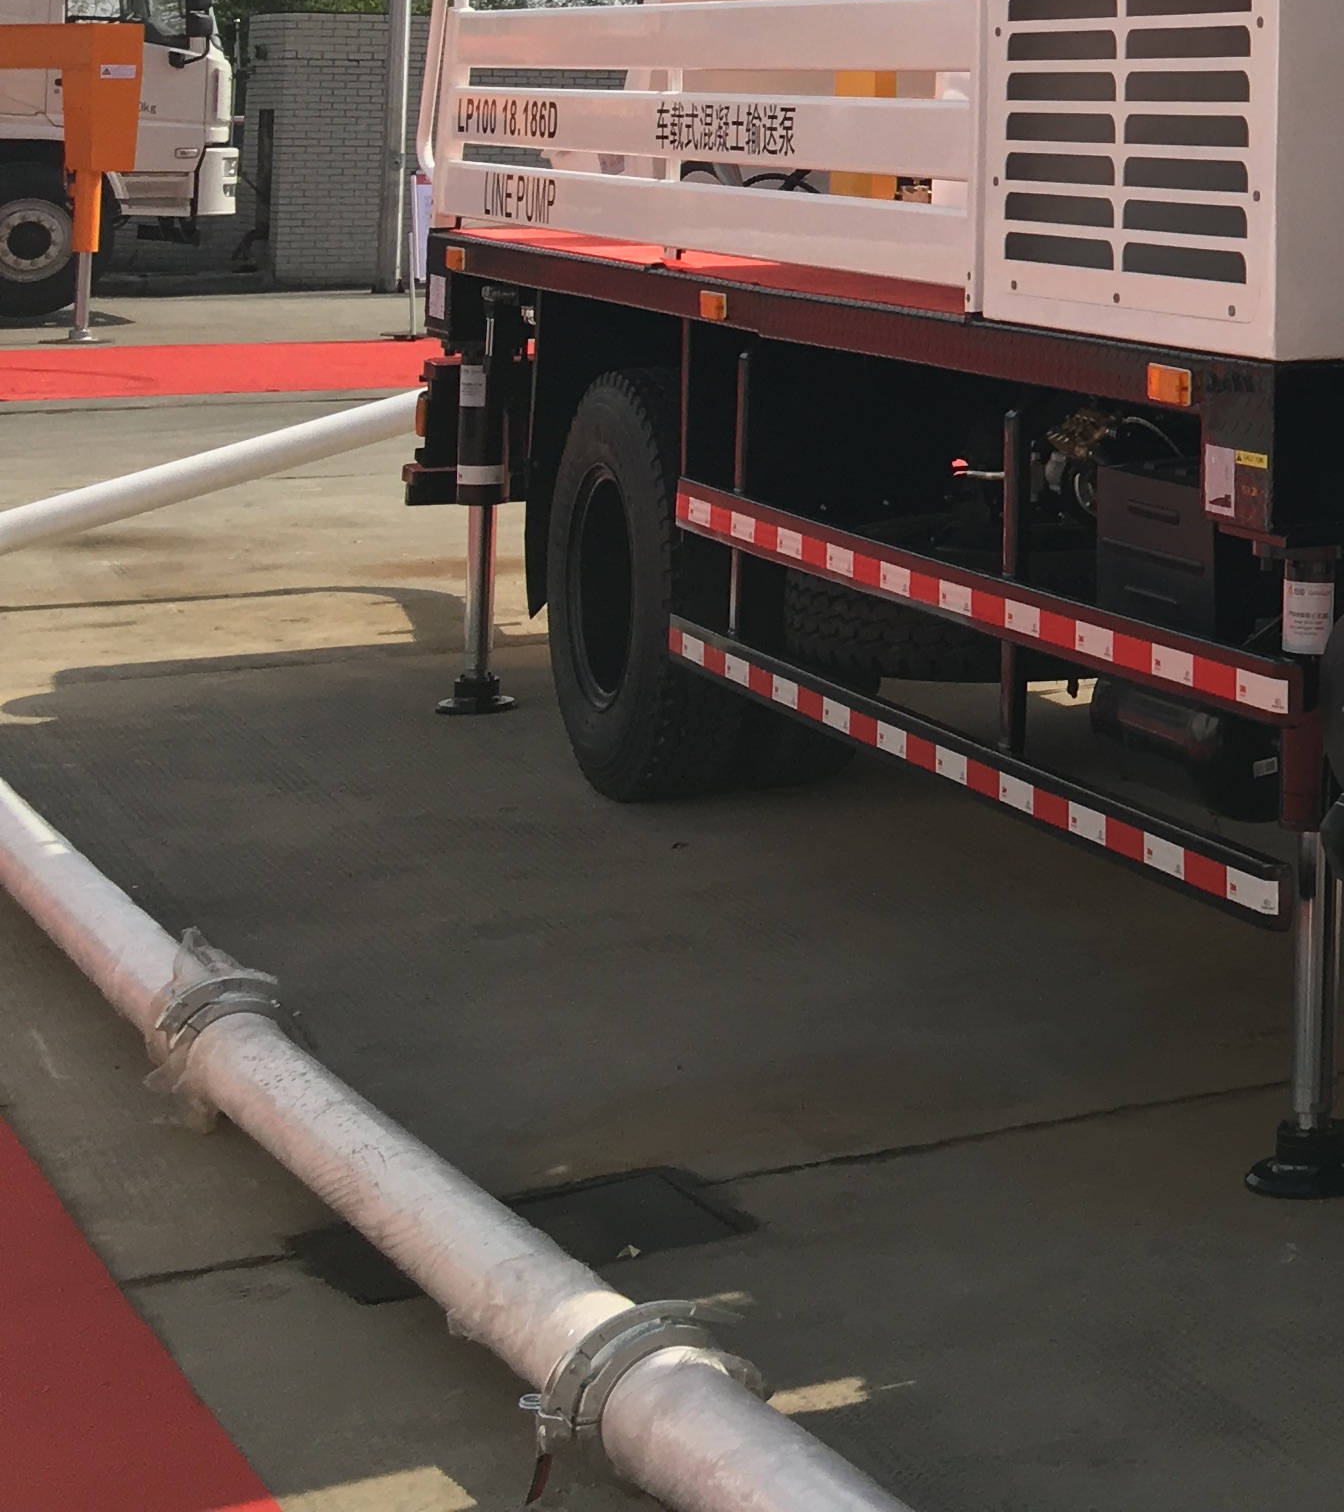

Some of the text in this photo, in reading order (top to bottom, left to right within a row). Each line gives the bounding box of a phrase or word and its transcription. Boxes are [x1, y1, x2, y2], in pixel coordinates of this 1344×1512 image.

[457, 98, 558, 138] LP100 18.186D
[655, 101, 796, 156] 车载式混凝土输送泵
[484, 171, 556, 224] LINE PUMP
